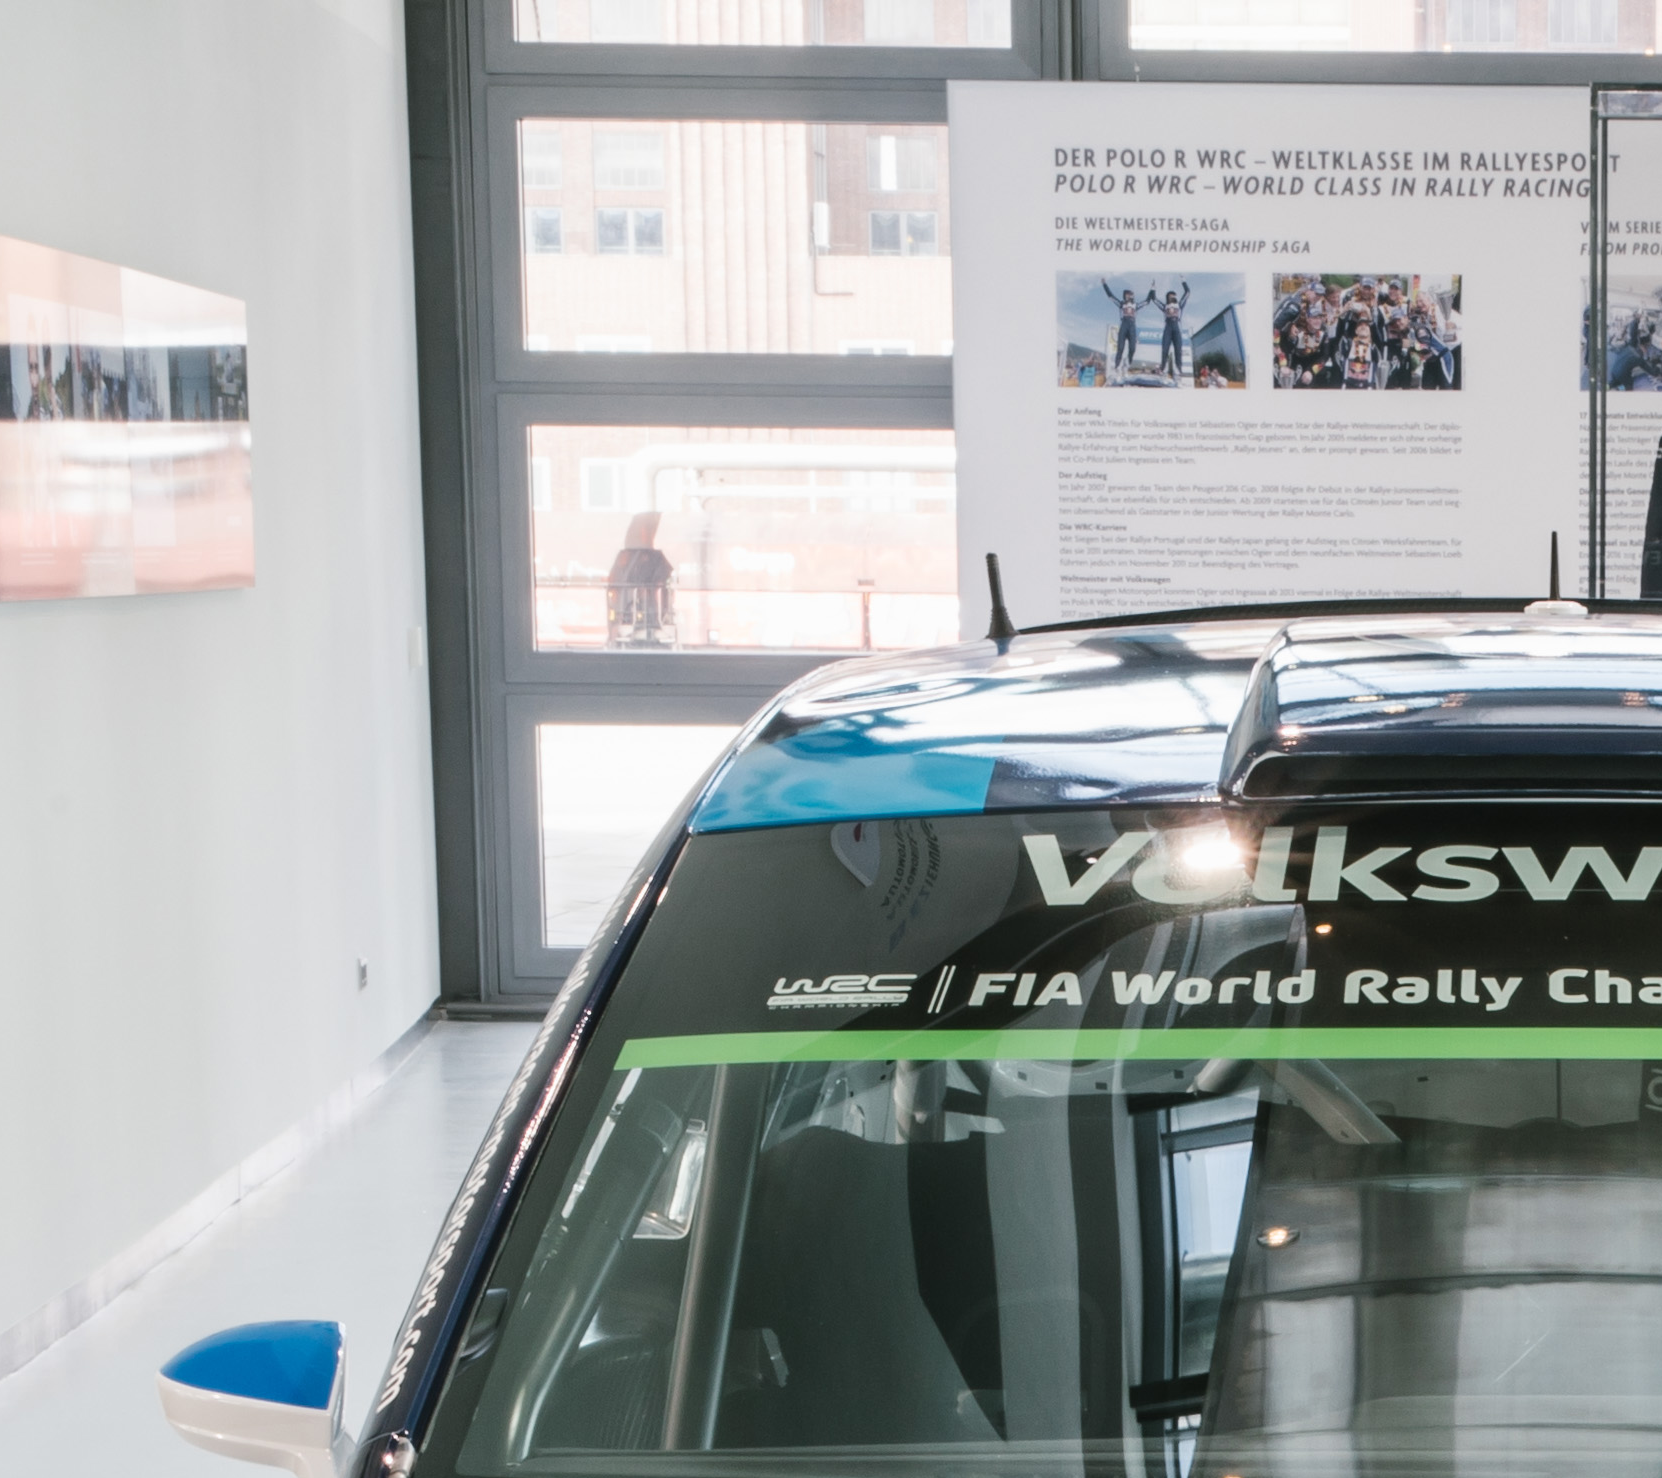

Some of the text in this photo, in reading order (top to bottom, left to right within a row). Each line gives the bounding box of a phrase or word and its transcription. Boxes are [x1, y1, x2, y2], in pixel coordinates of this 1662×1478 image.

[1054, 147, 1096, 167] DER
[1106, 148, 1166, 168] POLO
[1174, 148, 1187, 168] R
[1196, 149, 1246, 169] WRC
[1272, 149, 1413, 171] WELTKLASSE
[1423, 151, 1450, 171] IM
[1460, 151, 1620, 173] RALLYESPOT
[1054, 173, 1115, 194] POLO
[1123, 174, 1137, 194] R
[1147, 174, 1197, 195] WRC
[1223, 174, 1304, 196] WORLD
[1314, 176, 1382, 196] CLASS
[1391, 176, 1416, 196] IN
[1425, 177, 1495, 197] RALLY
[1503, 177, 1591, 198] RACING
[1055, 216, 1230, 232] DIE WELTMEISTER-SAGA
[1580, 221, 1620, 235] VM
[1056, 237, 1310, 254] THE WORLD CHAMPIONSHIP SAGA
[1580, 241, 1627, 256] FOM
[968, 972, 1083, 1006] FIA
[1111, 968, 1316, 1005] World
[1343, 967, 1523, 1012] Rally
